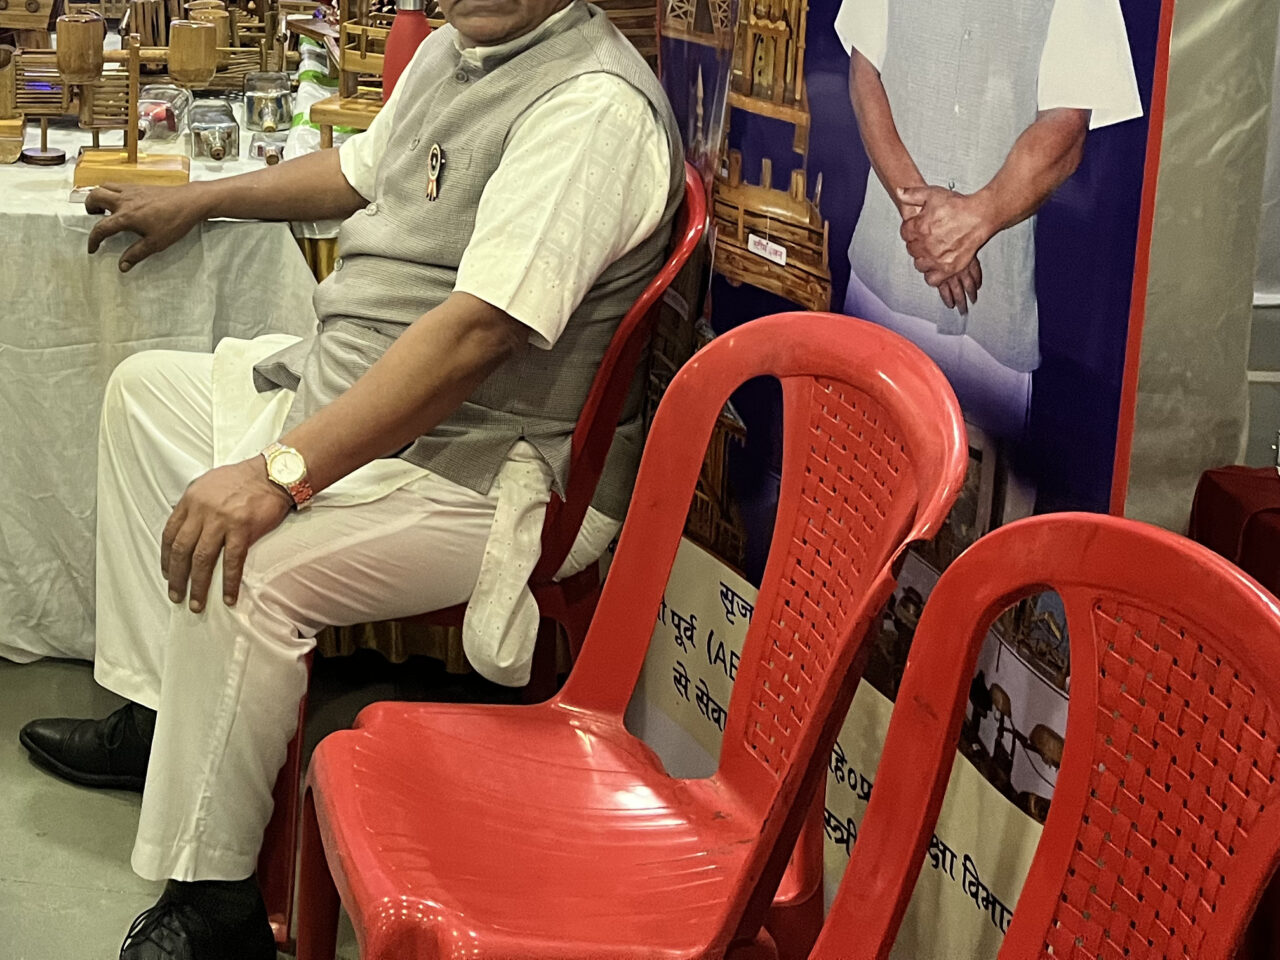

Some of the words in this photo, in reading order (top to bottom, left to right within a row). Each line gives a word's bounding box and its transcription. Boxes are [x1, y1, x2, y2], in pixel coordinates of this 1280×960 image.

[720, 581, 754, 625] सृज
[670, 613, 697, 654] पूर्व
[707, 629, 740, 682] (AE
[829, 740, 873, 803] हि०प्र
[927, 832, 958, 882] क्षा
[962, 854, 1013, 936] विभा
[673, 660, 691, 702] से
[695, 677, 727, 732] सेवा
[823, 808, 857, 858] स्त्री
